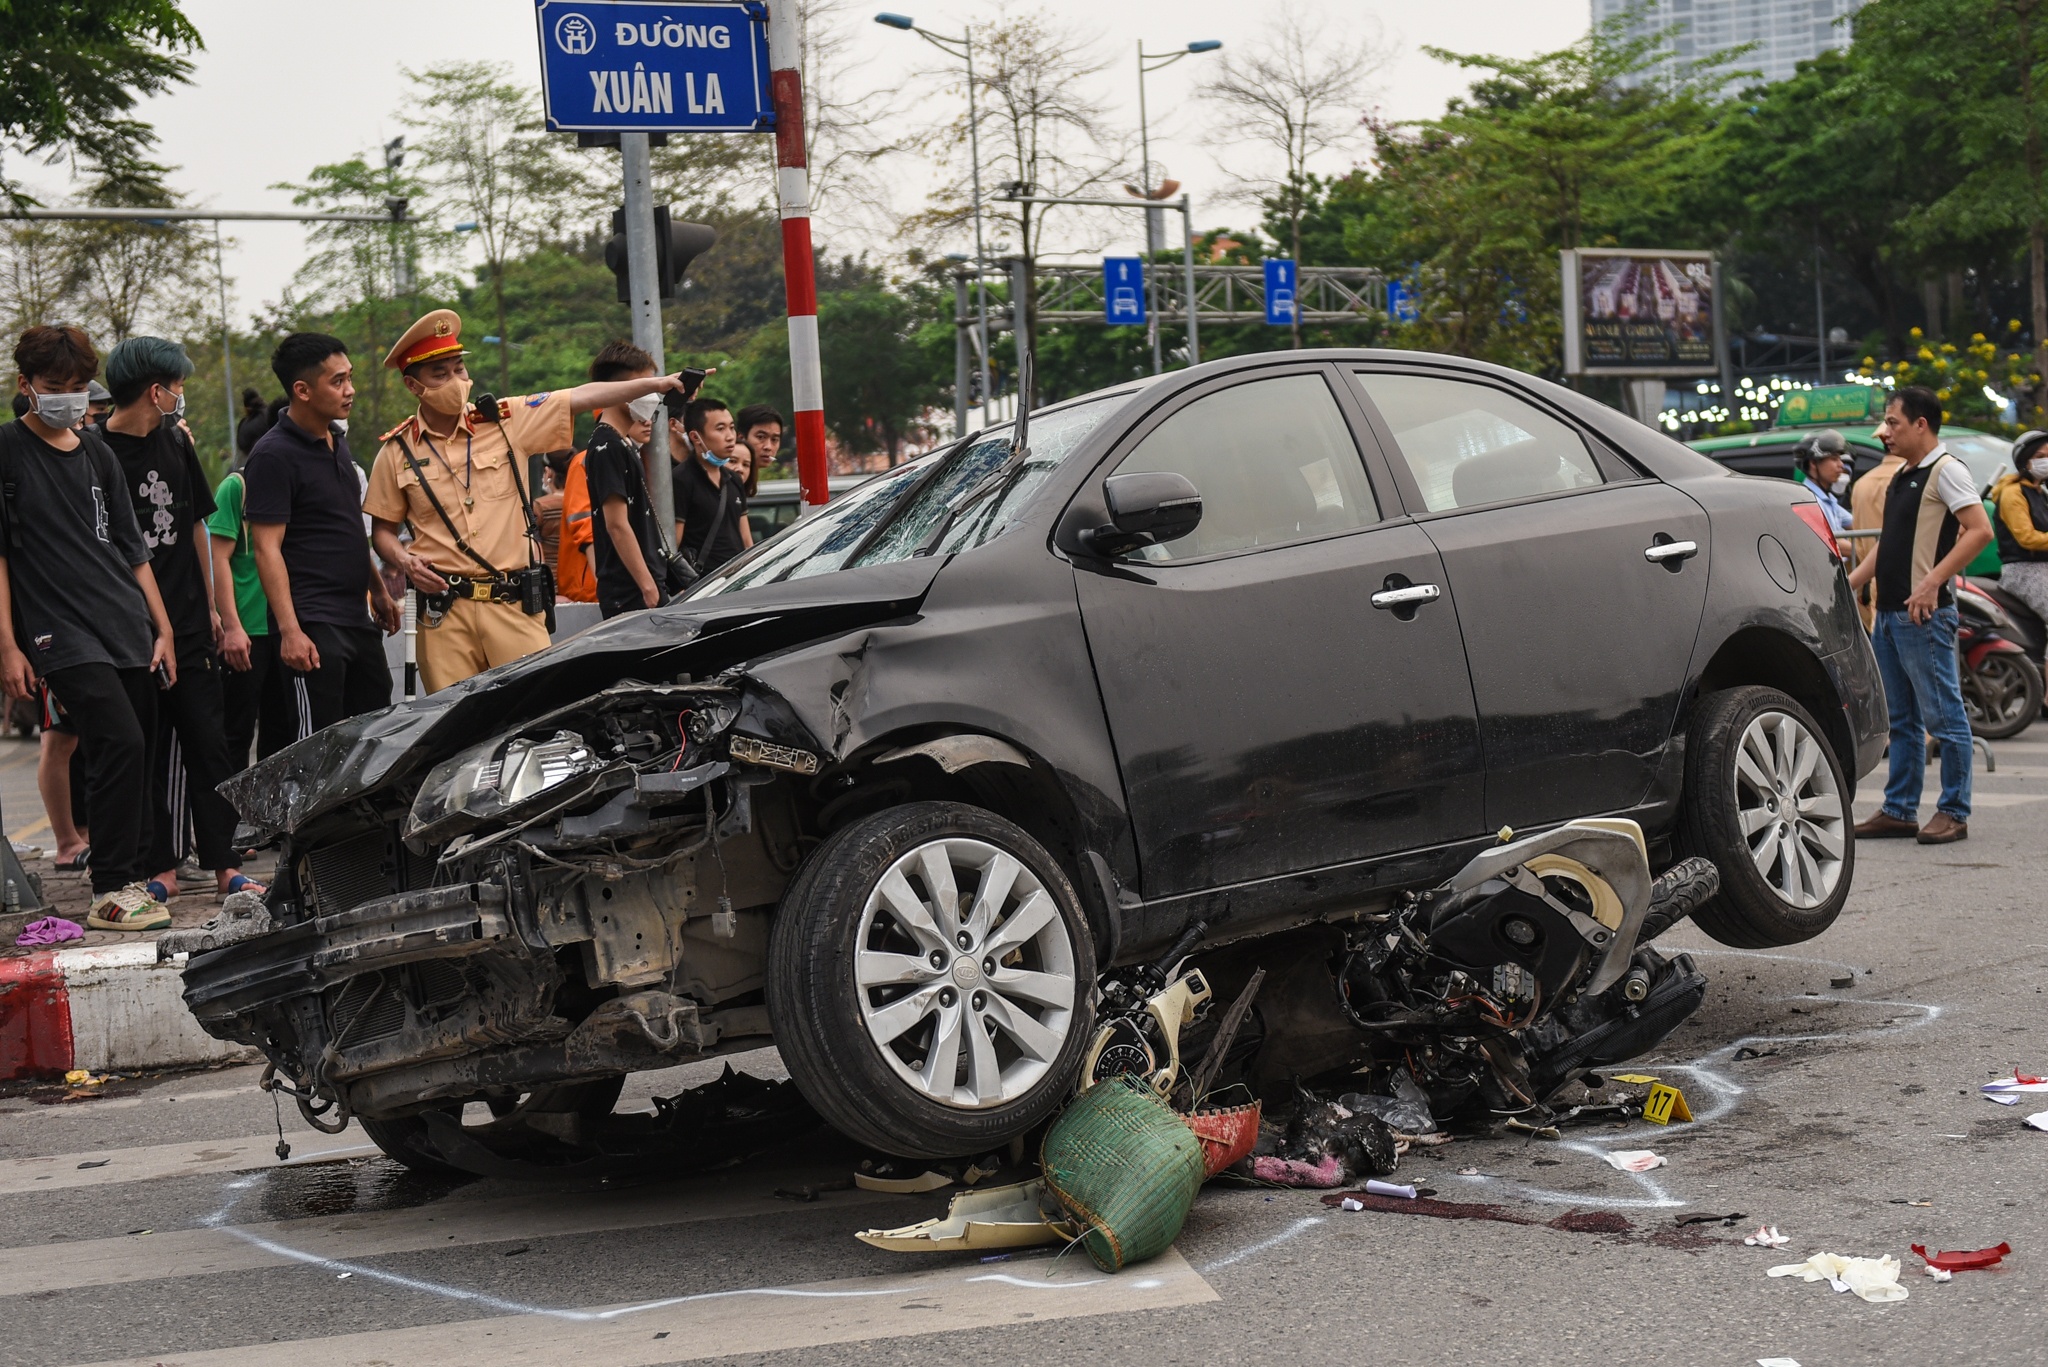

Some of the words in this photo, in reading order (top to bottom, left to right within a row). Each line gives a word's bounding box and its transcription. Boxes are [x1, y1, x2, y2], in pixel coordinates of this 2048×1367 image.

[614, 15, 731, 49] ĐƯỜNG
[589, 61, 674, 114] XUÂN
[685, 72, 726, 115] LA
[1624, 323, 1665, 337] GARDEN
[1748, 694, 1801, 713] BRIDGESTONE
[1651, 1089, 1672, 1116] 17
